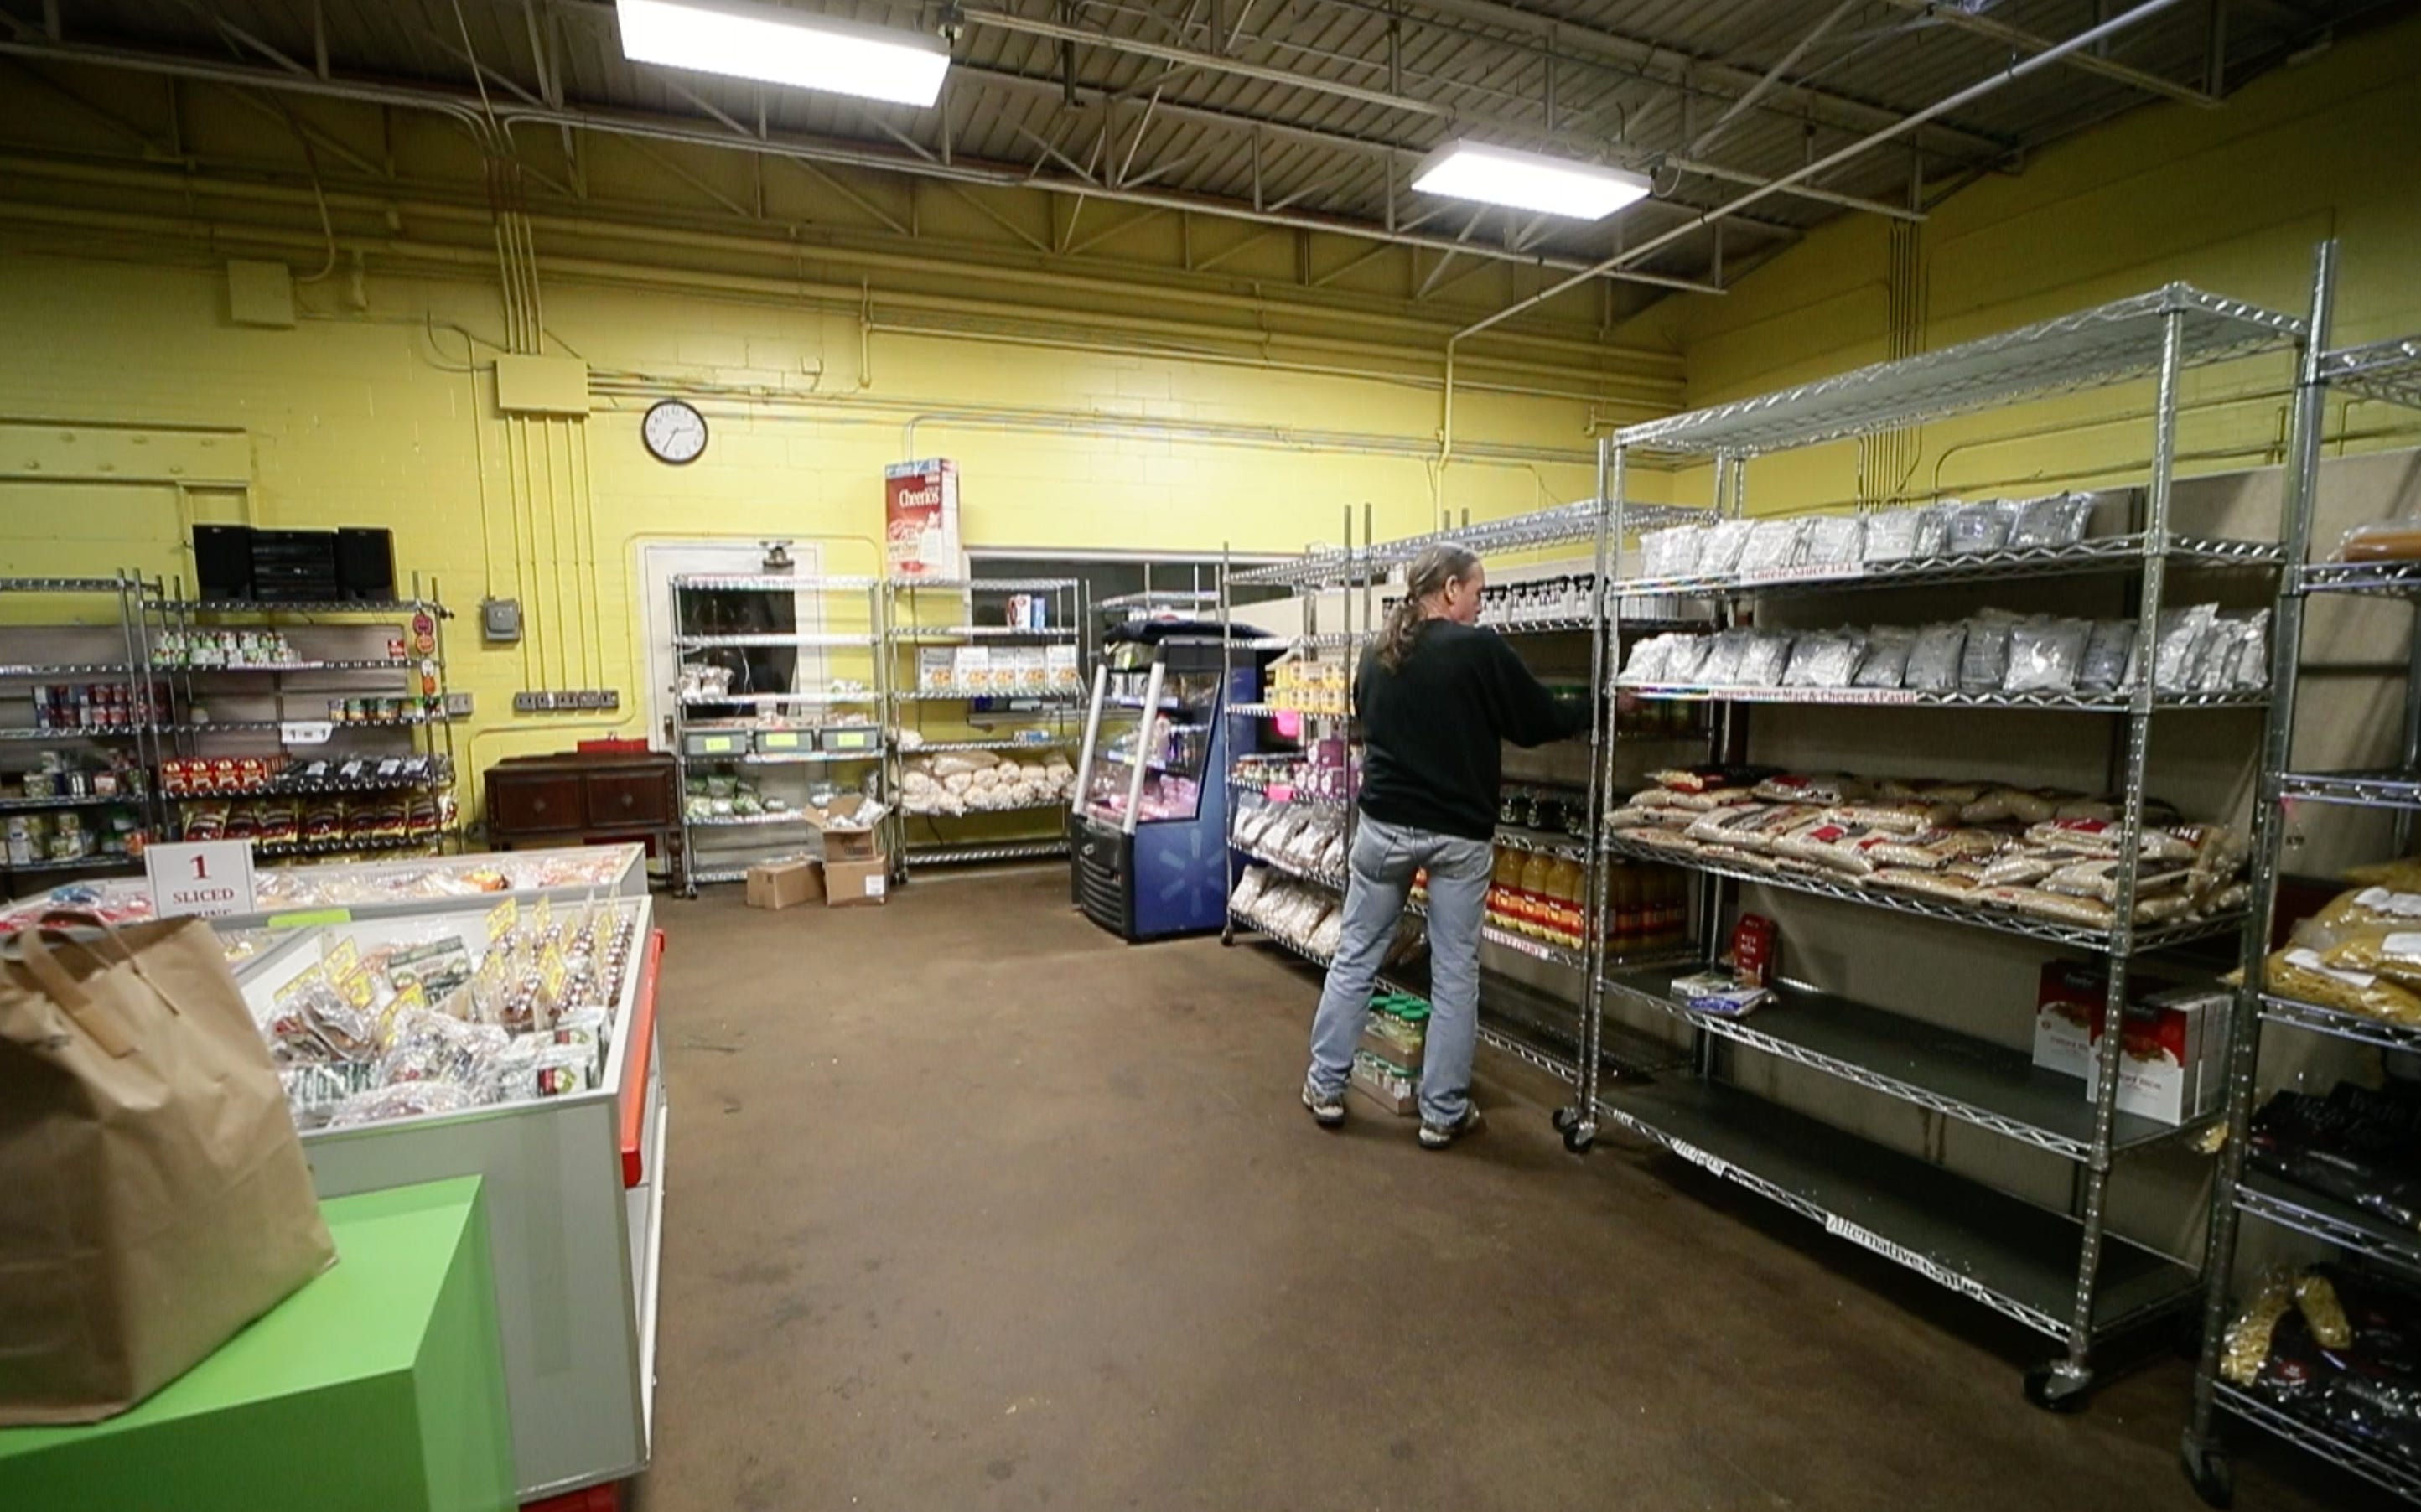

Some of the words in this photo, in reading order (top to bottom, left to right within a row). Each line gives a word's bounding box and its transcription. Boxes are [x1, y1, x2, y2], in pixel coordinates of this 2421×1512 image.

[899, 488, 939, 508] Cheerios
[1821, 691, 1864, 702] Cheese
[189, 854, 212, 880] 1
[173, 888, 234, 904] SLICED
[1828, 1216, 1921, 1267] Alternative
